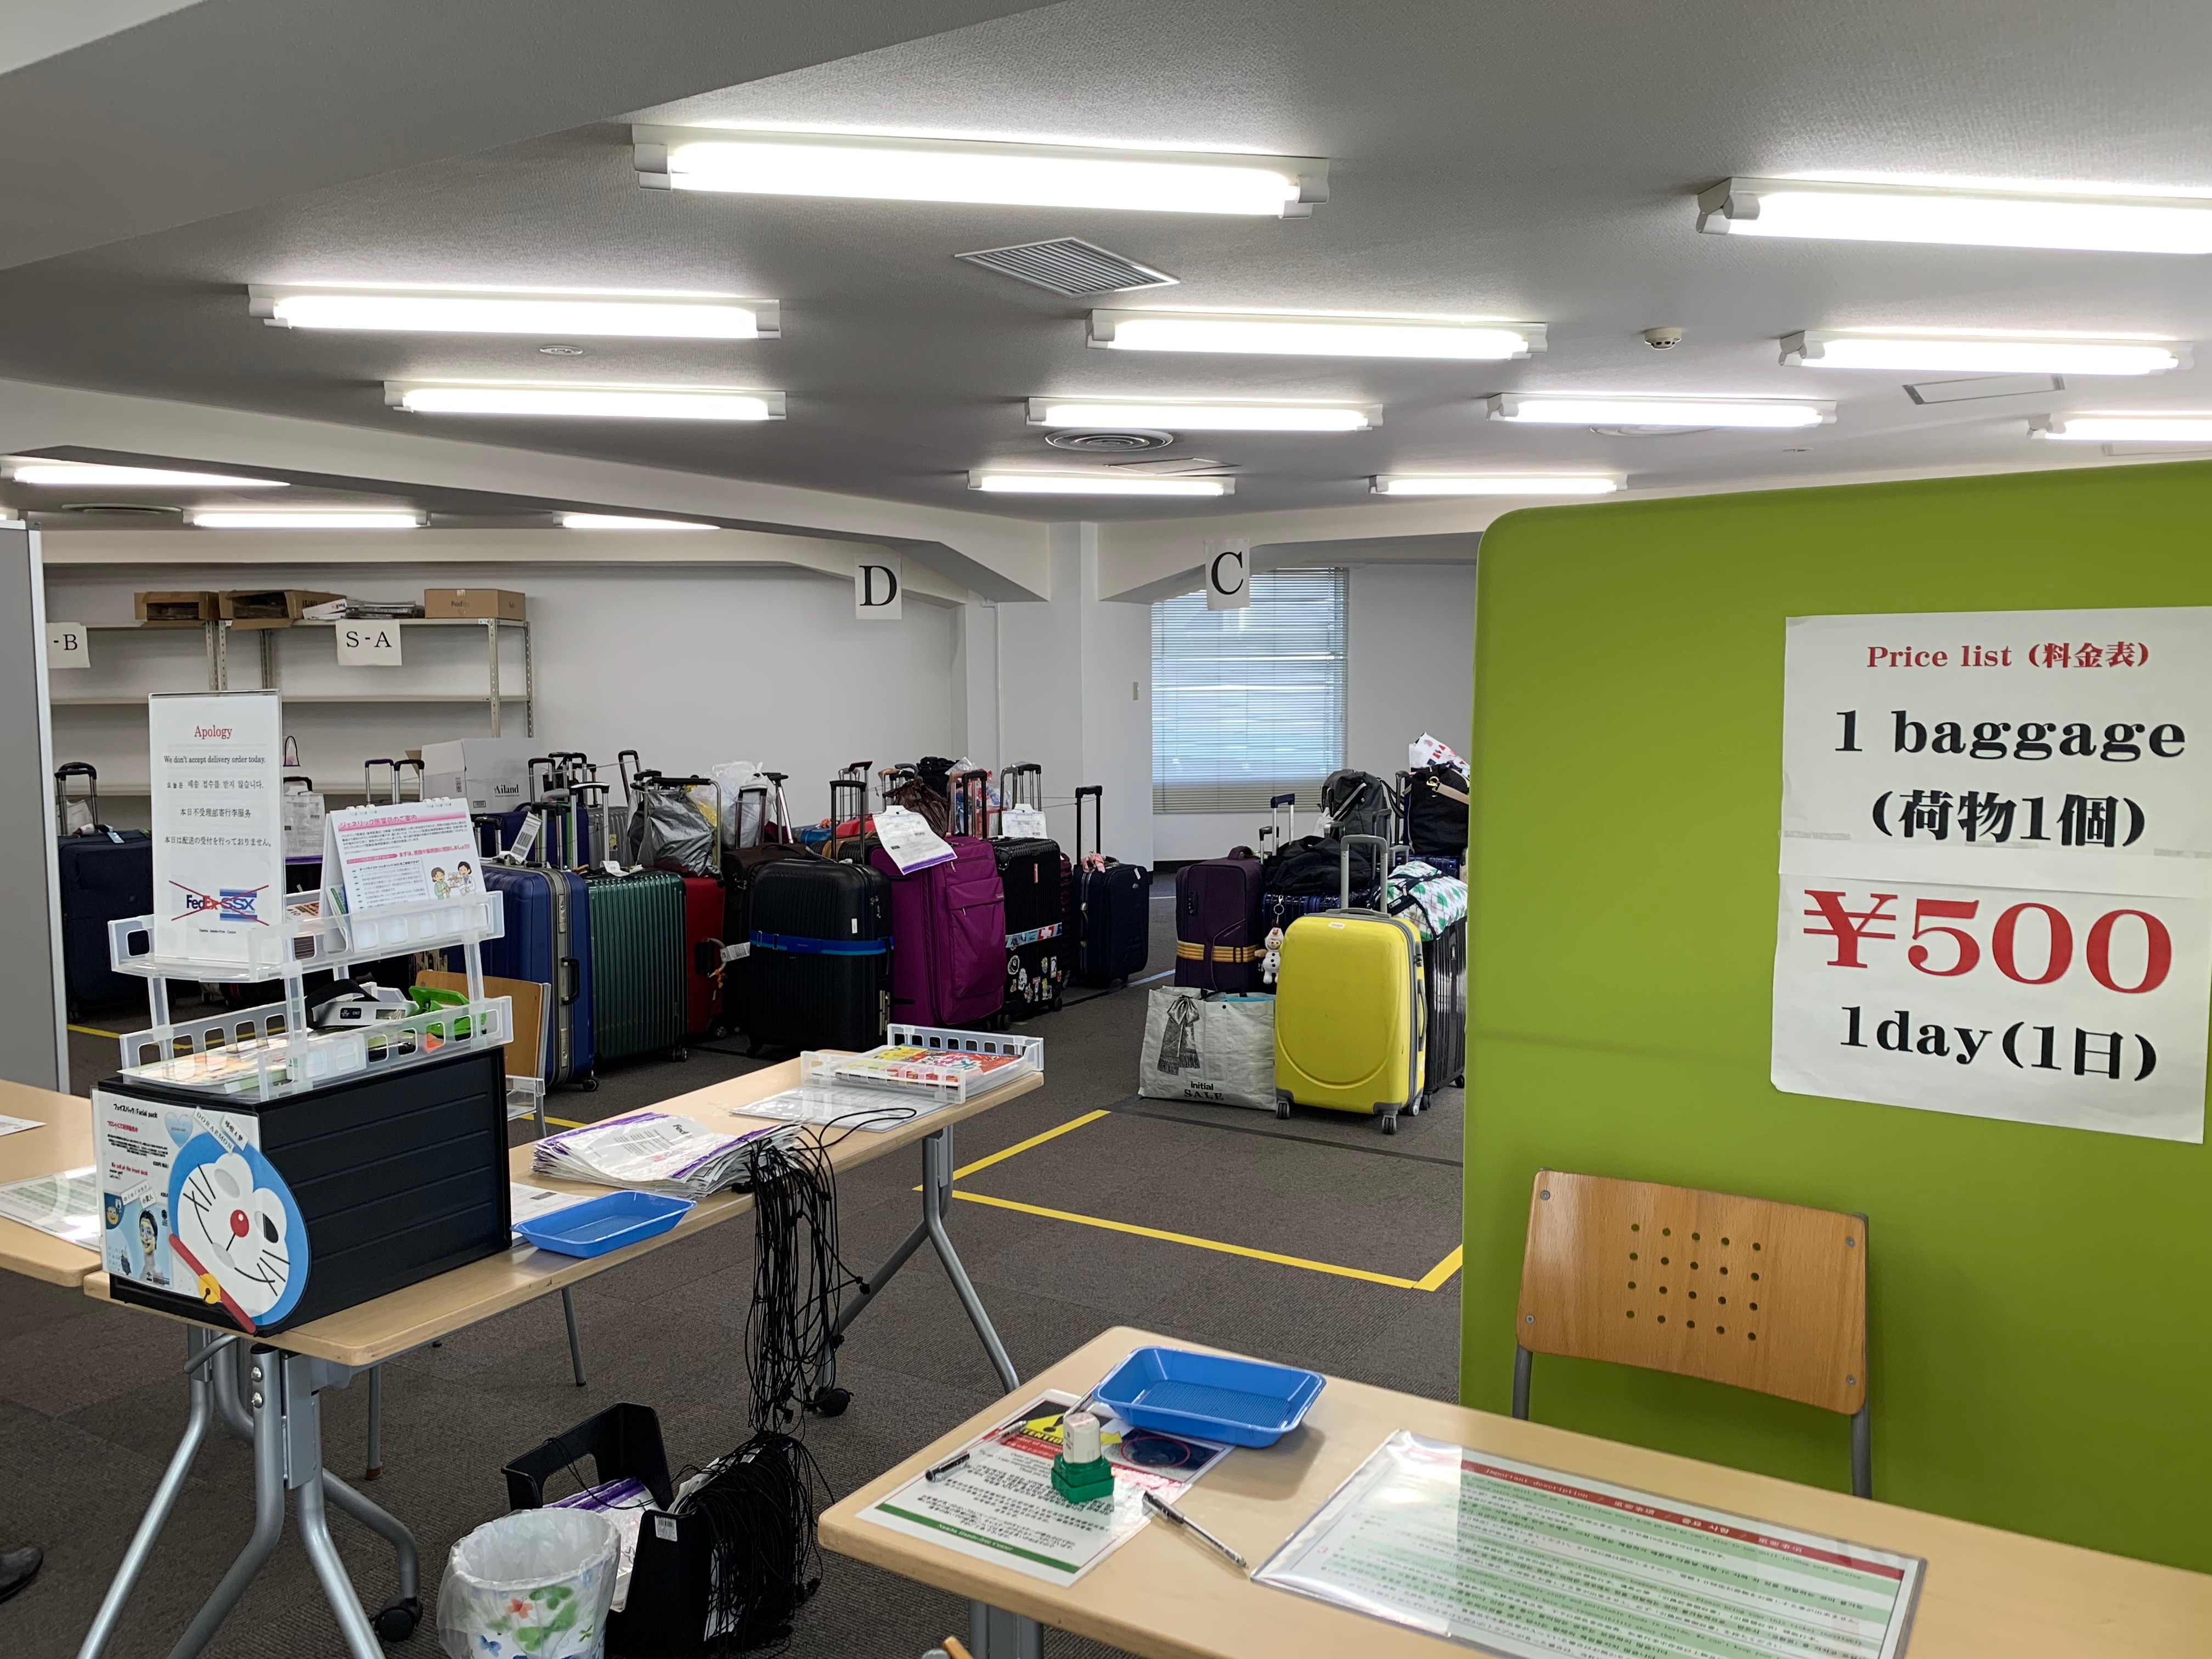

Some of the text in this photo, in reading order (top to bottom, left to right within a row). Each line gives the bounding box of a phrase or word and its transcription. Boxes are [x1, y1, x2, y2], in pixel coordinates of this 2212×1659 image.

[1211, 551, 1244, 595] C
[859, 565, 898, 606] D
[54, 634, 78, 651] -B
[1867, 641, 2150, 669] Price list (料金表)
[194, 725, 233, 740] Apology
[1835, 709, 2187, 763] 1 baggage
[207, 755, 231, 765] delivery
[249, 755, 266, 765] today.
[223, 780, 235, 789] 받지
[494, 784, 519, 794] Ailand
[1872, 789, 2146, 848] (荷物1個)
[1803, 889, 2172, 995] ¥500
[1184, 1089, 1224, 1101] SALE
[1190, 1081, 1214, 1091] initial
[196, 1112, 232, 1149] DORAEMON
